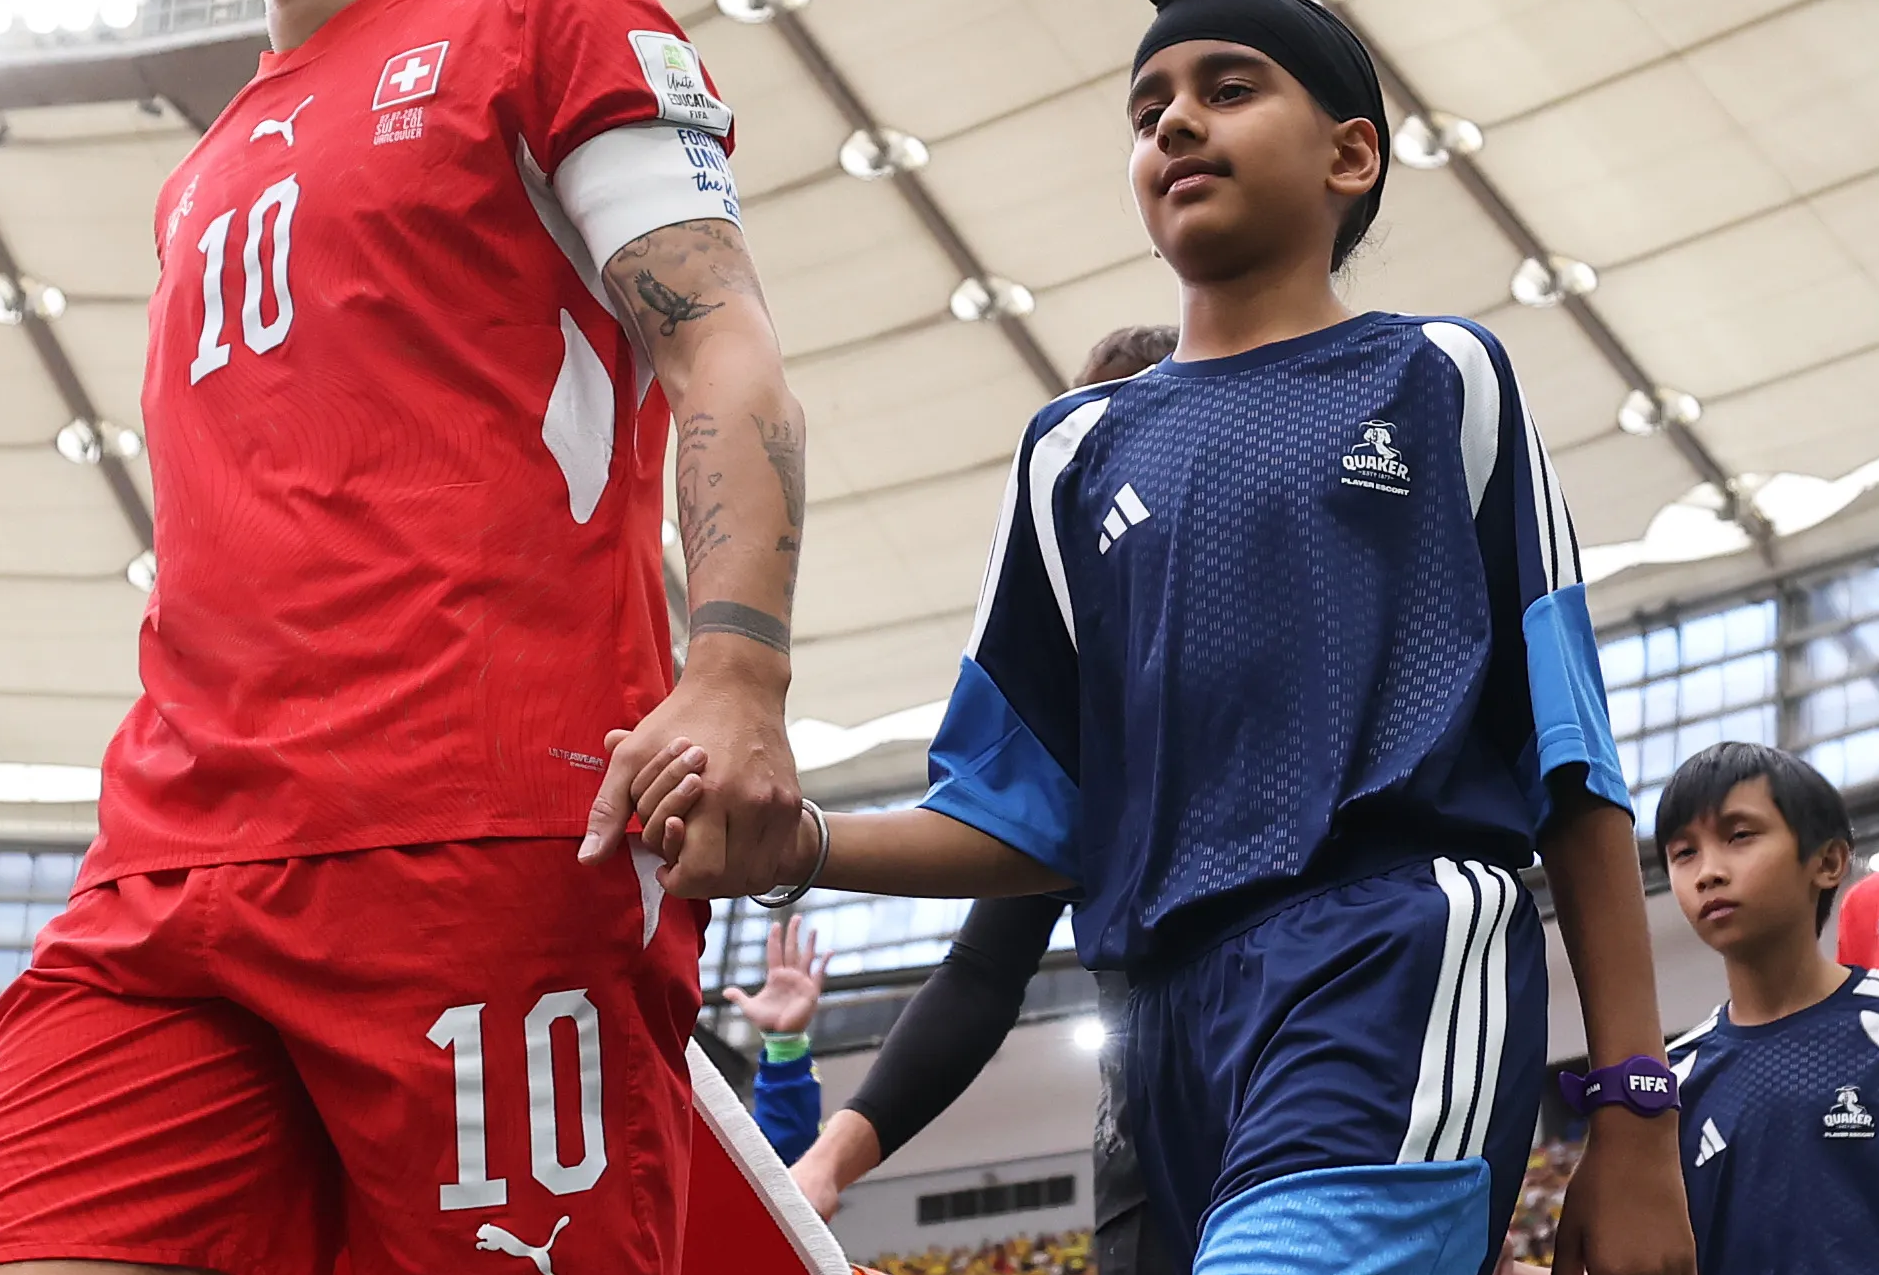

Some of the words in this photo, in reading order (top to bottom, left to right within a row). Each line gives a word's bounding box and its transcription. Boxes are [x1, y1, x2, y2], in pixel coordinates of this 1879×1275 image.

[689, 110, 709, 120] FIFA
[373, 128, 422, 145] VANCOUVER
[190, 172, 300, 386] 10
[1342, 454, 1409, 480] QUAKER
[1341, 477, 1375, 489] PLAYER
[1375, 483, 1410, 496] ESCORT
[1629, 1074, 1668, 1094] FIFA
[425, 988, 609, 1213] 10
[1823, 1112, 1873, 1127] QUAKER
